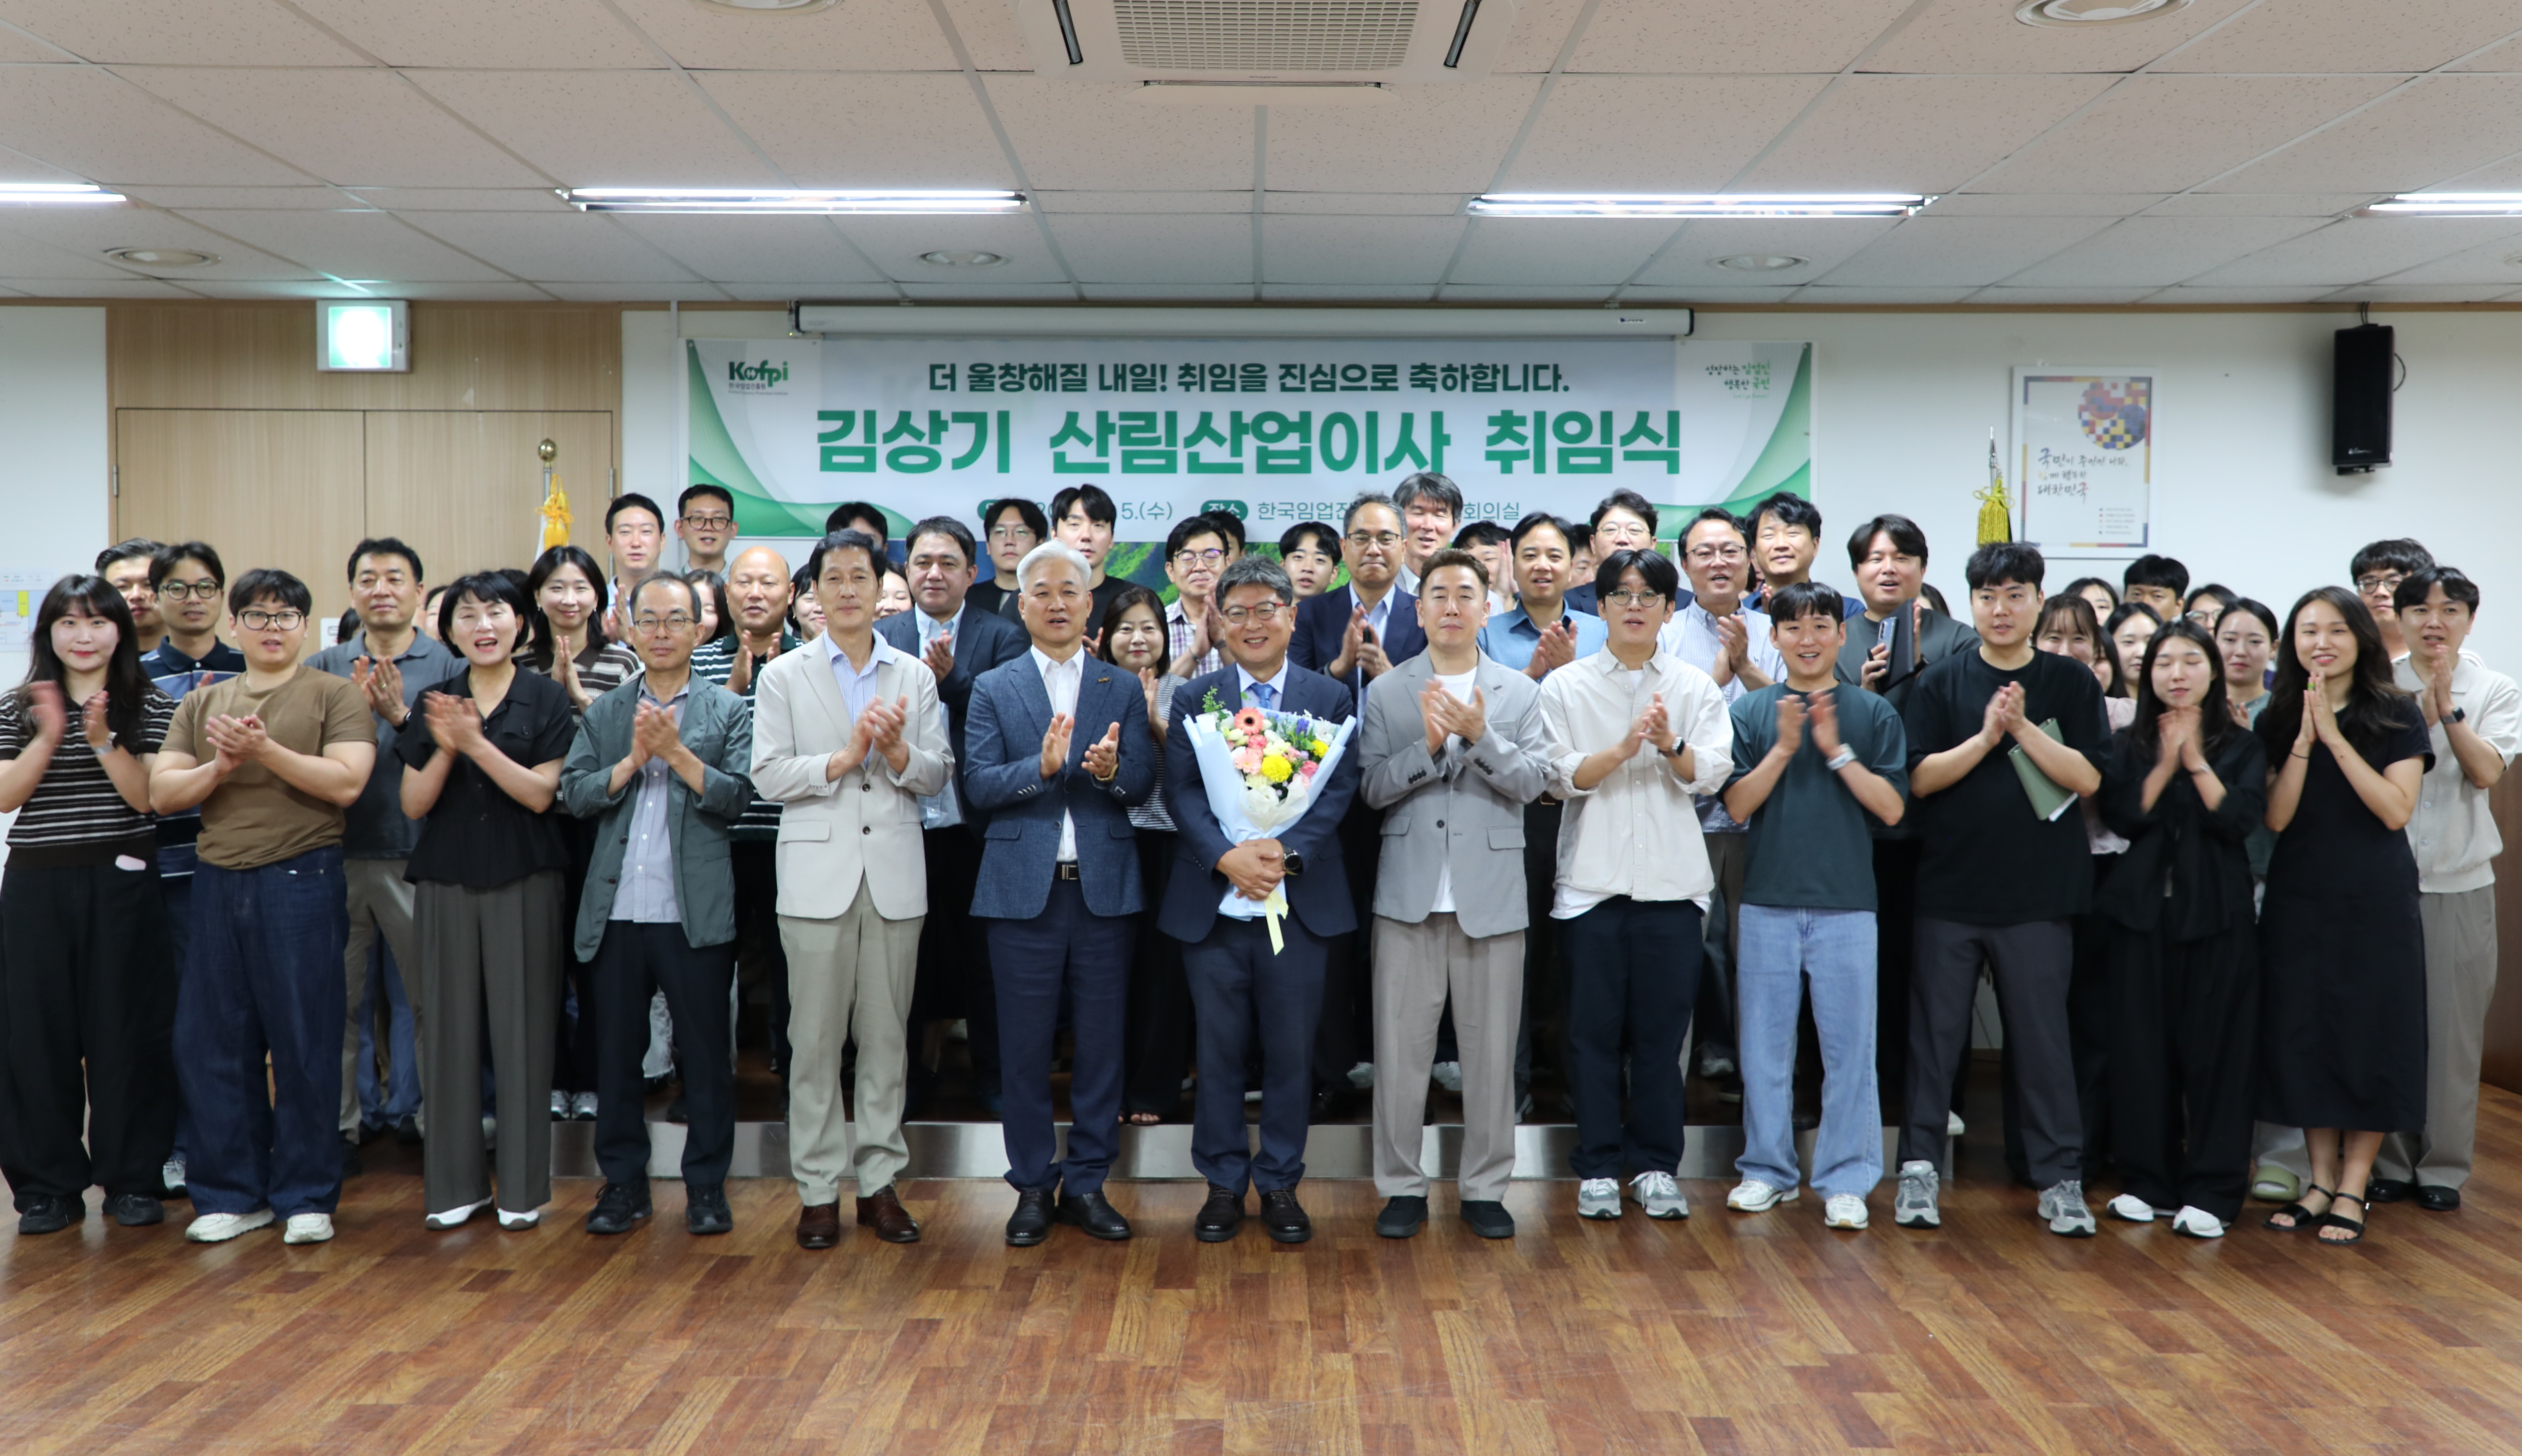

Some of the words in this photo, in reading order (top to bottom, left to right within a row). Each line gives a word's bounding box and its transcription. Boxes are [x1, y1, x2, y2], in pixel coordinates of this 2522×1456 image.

[729, 360, 788, 387] Kofpi
[930, 363, 956, 391] 더
[968, 363, 1087, 392] 울창해질
[1099, 364, 1167, 392] 내일!
[1178, 363, 1267, 392] 취임을
[1279, 364, 1399, 392] 진심으로
[1409, 363, 1569, 393] 축하합니다.
[1742, 359, 1770, 375] 임업인
[1753, 377, 1770, 390] 국민
[817, 410, 1010, 474] 김상기
[1050, 410, 1451, 474] 산림산업이사
[1485, 410, 1680, 474] 취임식
[1258, 502, 1352, 520] 한국임업진
